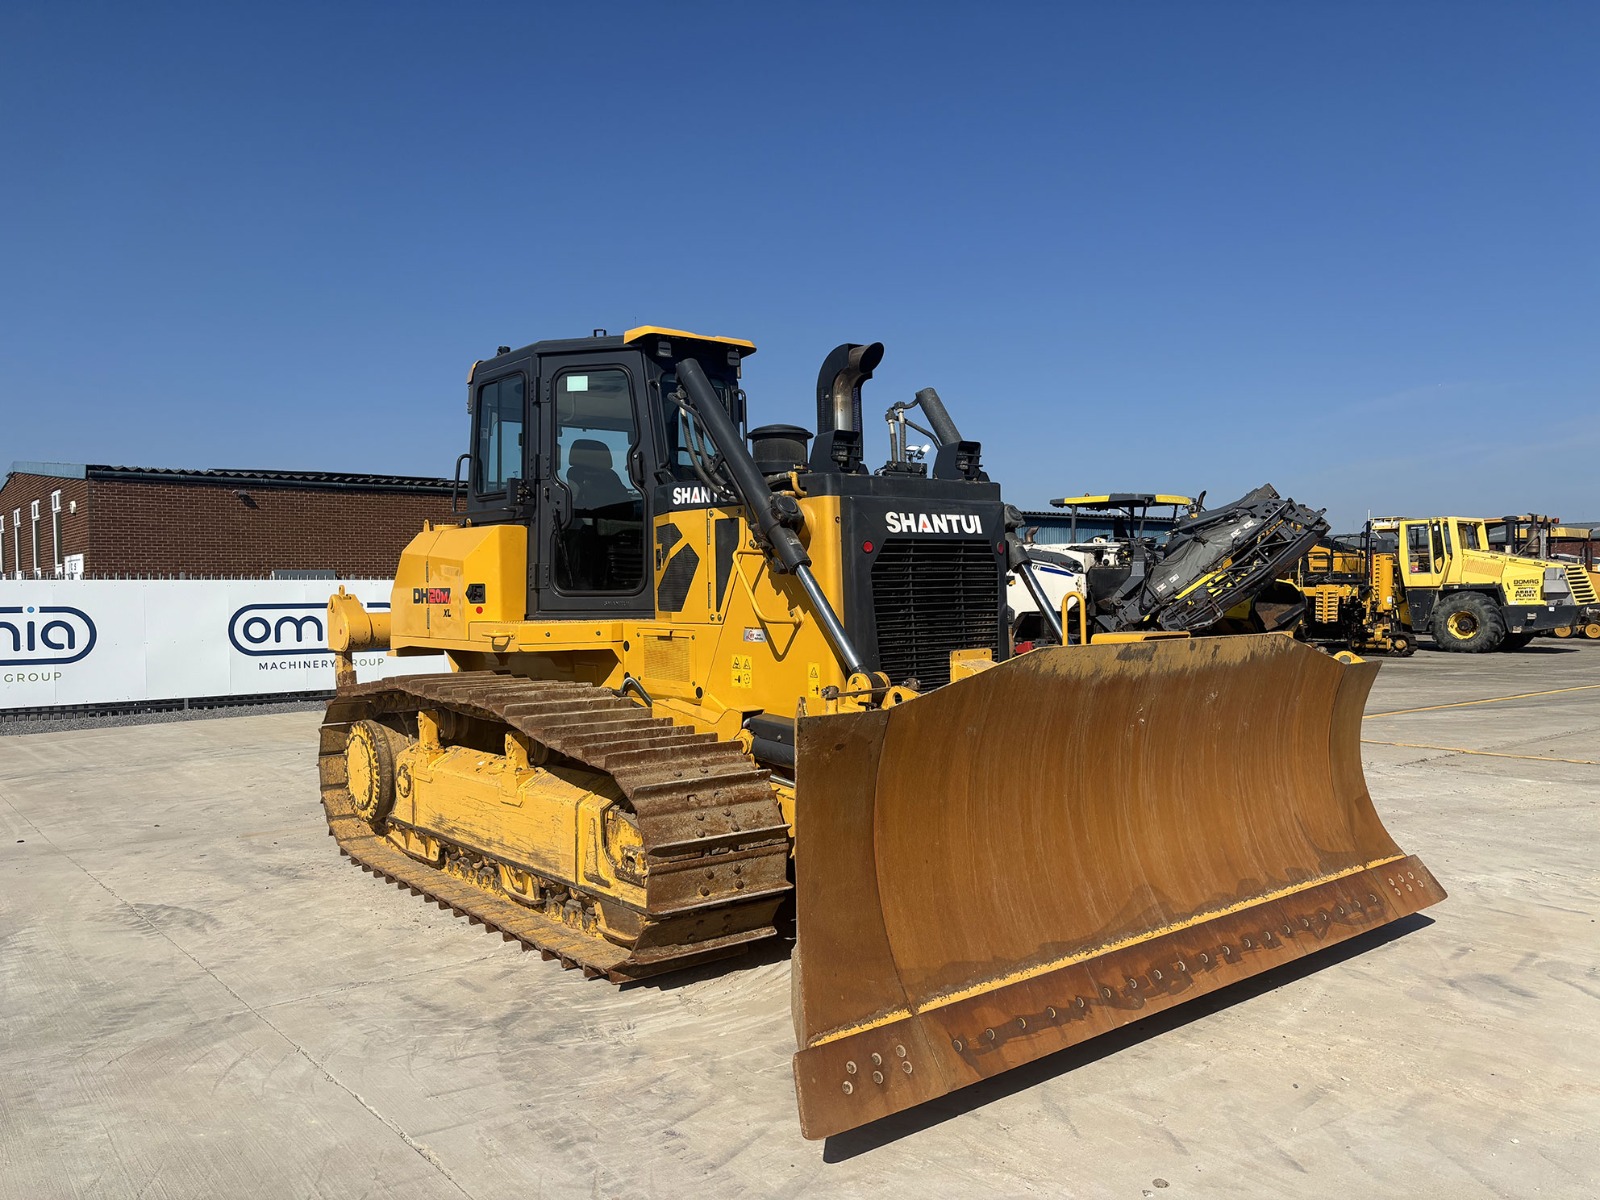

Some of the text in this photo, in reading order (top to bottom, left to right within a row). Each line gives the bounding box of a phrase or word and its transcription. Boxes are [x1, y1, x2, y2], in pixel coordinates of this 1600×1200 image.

[672, 486, 728, 505] SHAN
[885, 511, 983, 534] SHANTUI
[443, 609, 451, 617] XL
[0, 606, 76, 652] nia
[258, 657, 384, 671] MACHINERY ROUP
[3, 671, 62, 683] GROUP
